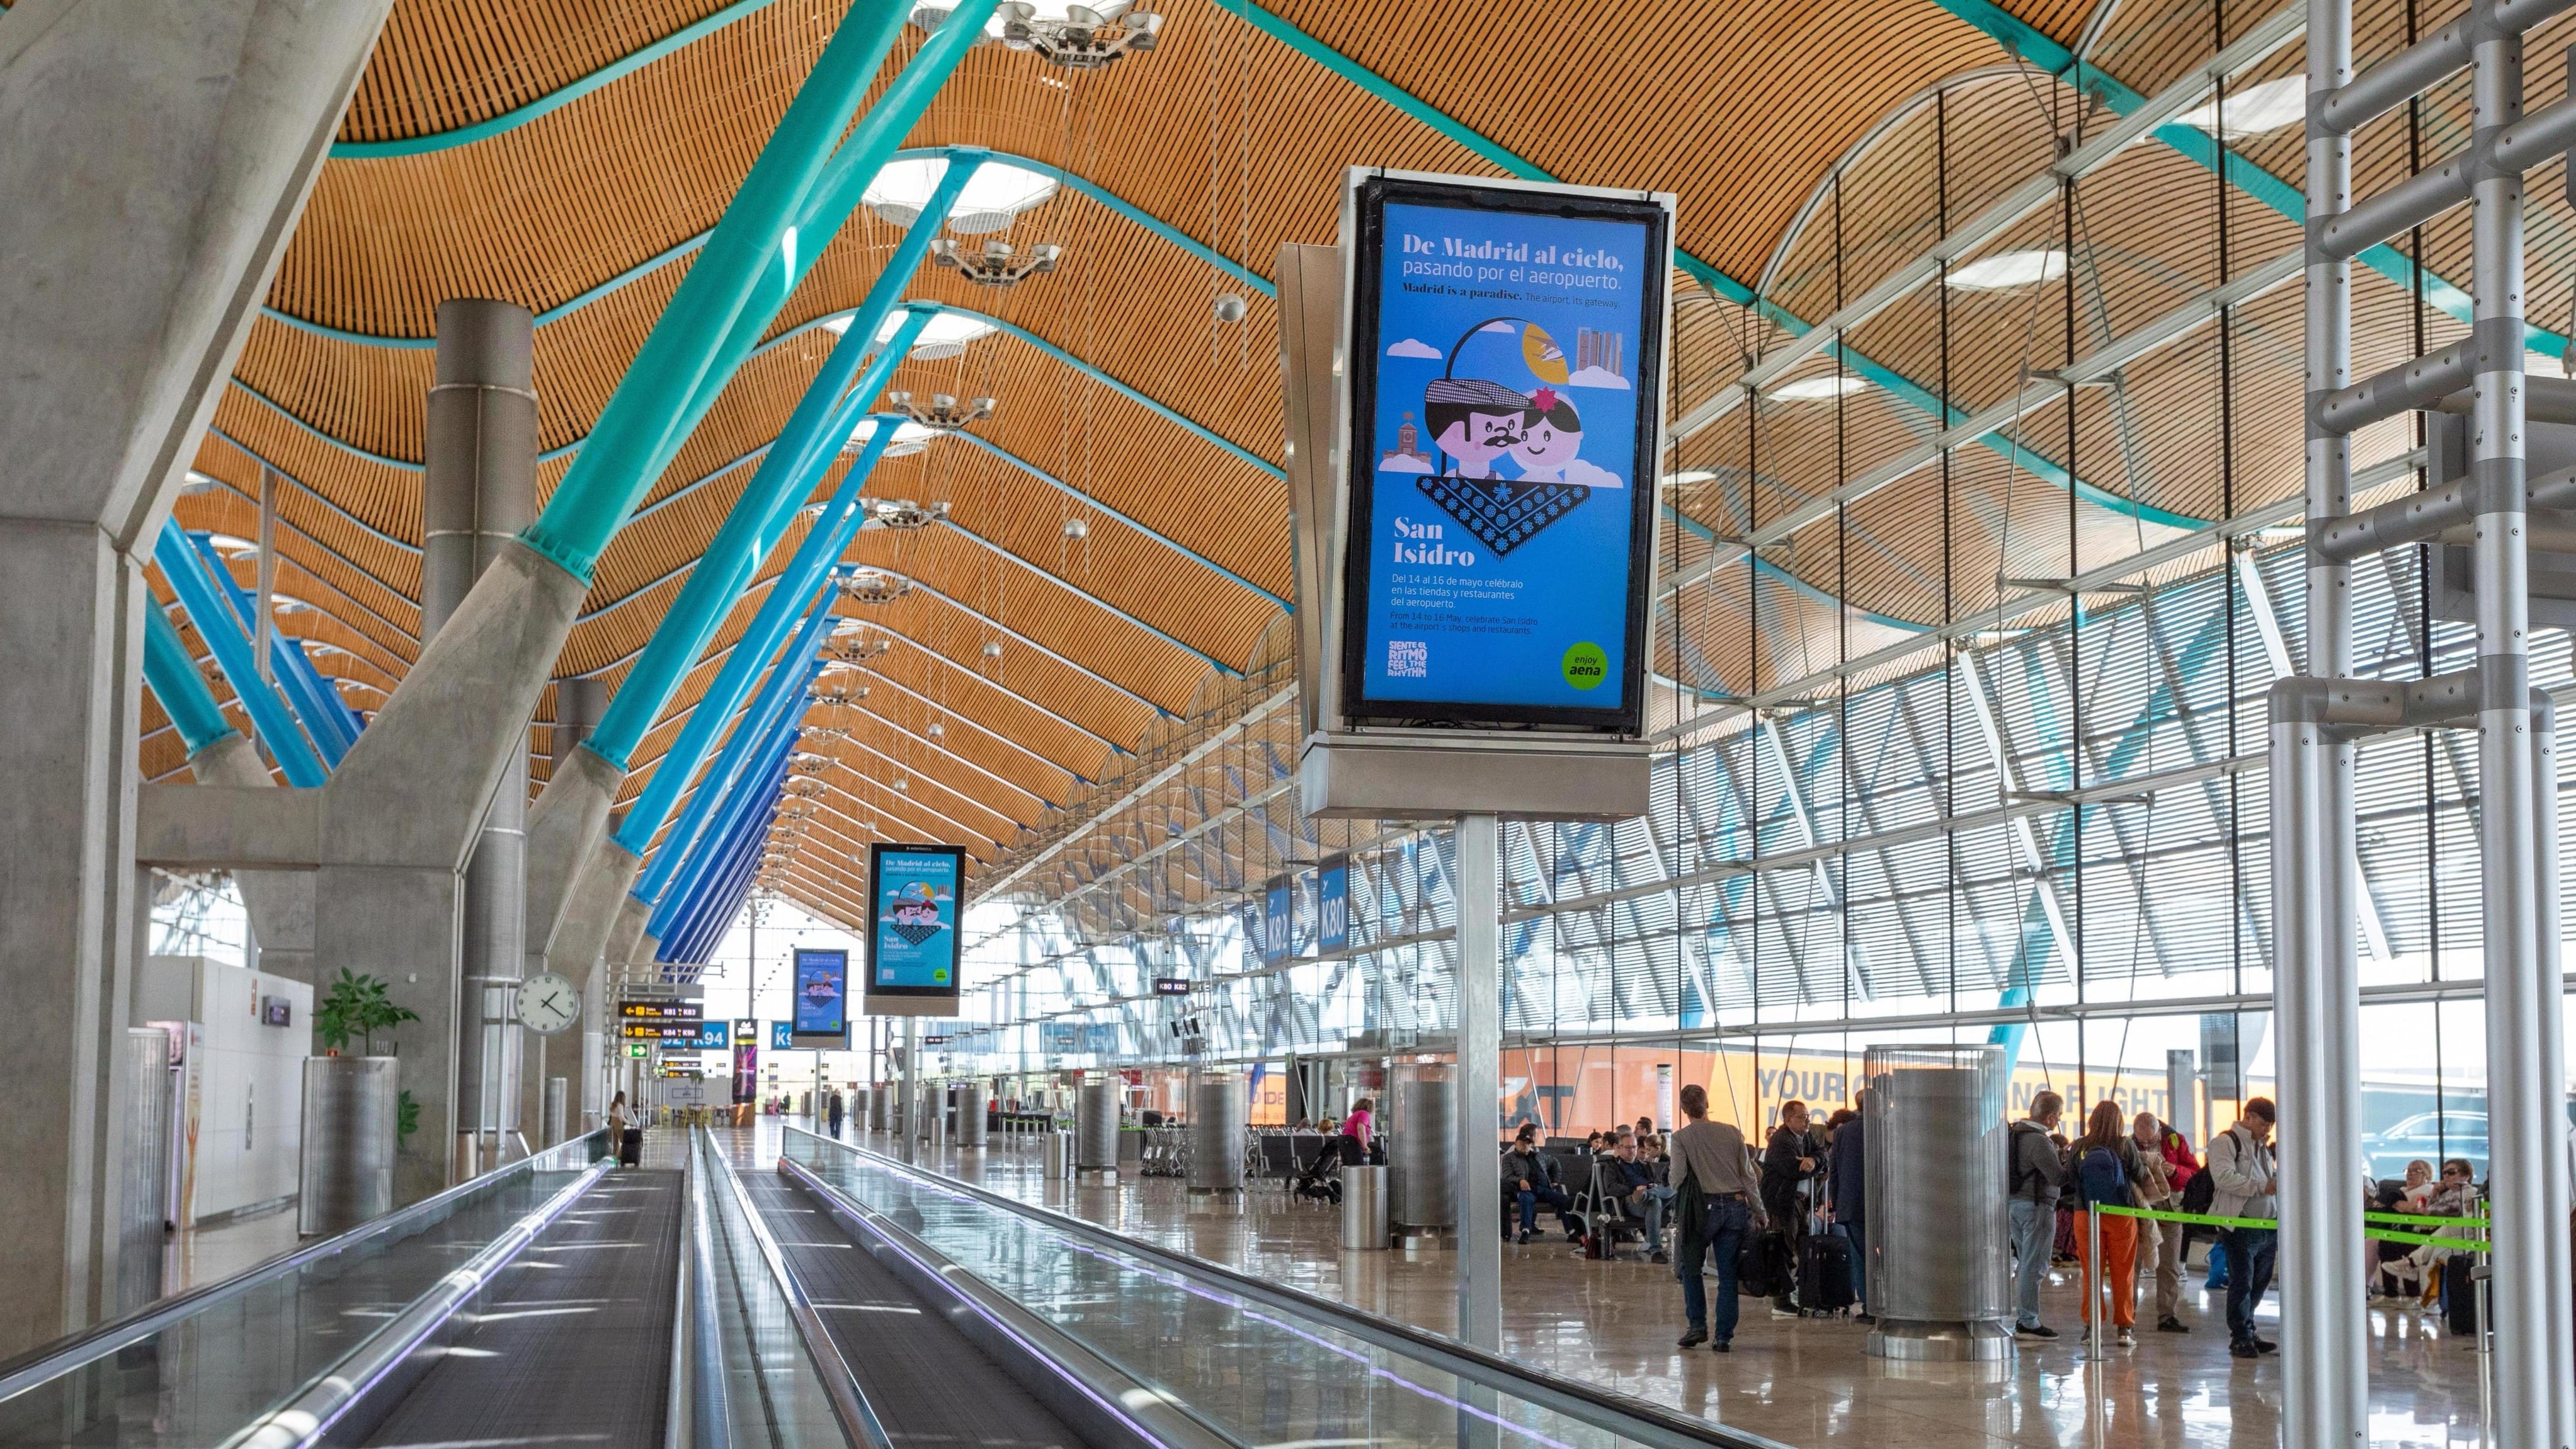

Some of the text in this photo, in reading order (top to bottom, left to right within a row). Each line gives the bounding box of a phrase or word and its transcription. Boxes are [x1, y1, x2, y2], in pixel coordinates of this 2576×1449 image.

[1403, 234, 1624, 272] De Madrid al cielo,
[1403, 261, 1621, 290] pasando por el aeropuerto.
[1403, 282, 1444, 295] Madrid
[1447, 284, 1457, 295] is
[1469, 288, 1522, 302] paradise.
[1526, 293, 1541, 302] The
[1543, 295, 1570, 305] airport,
[1573, 296, 1583, 304] its
[1585, 299, 1620, 309] gateway.
[1394, 517, 1442, 540] San
[1394, 543, 1474, 567] Isidro
[1392, 573, 1523, 588] Del 14 al 16 de mayo celébralo
[1391, 586, 1514, 599] en las tiendas y restaurantes
[1391, 597, 1456, 609] del aeropuerto.
[1391, 612, 1410, 621] From
[1412, 612, 1422, 621] 14
[1423, 613, 1432, 622] to
[1435, 614, 1444, 622] 16
[1465, 615, 1500, 625] celebrate
[1502, 616, 1516, 625] San
[1399, 621, 1411, 630] the
[1449, 623, 1470, 634] shops
[1473, 624, 1486, 633] and
[1389, 641, 1417, 650] SIENTE
[1389, 648, 1427, 660] RITMO
[1575, 655, 1597, 665] enjoy
[1388, 660, 1408, 670] FEEL
[1570, 666, 1600, 675] aena
[1388, 667, 1426, 677] RHYTHM
[1321, 896, 1344, 939] K80
[1268, 914, 1287, 953] K82
[1758, 1068, 1845, 1102] YOUR
